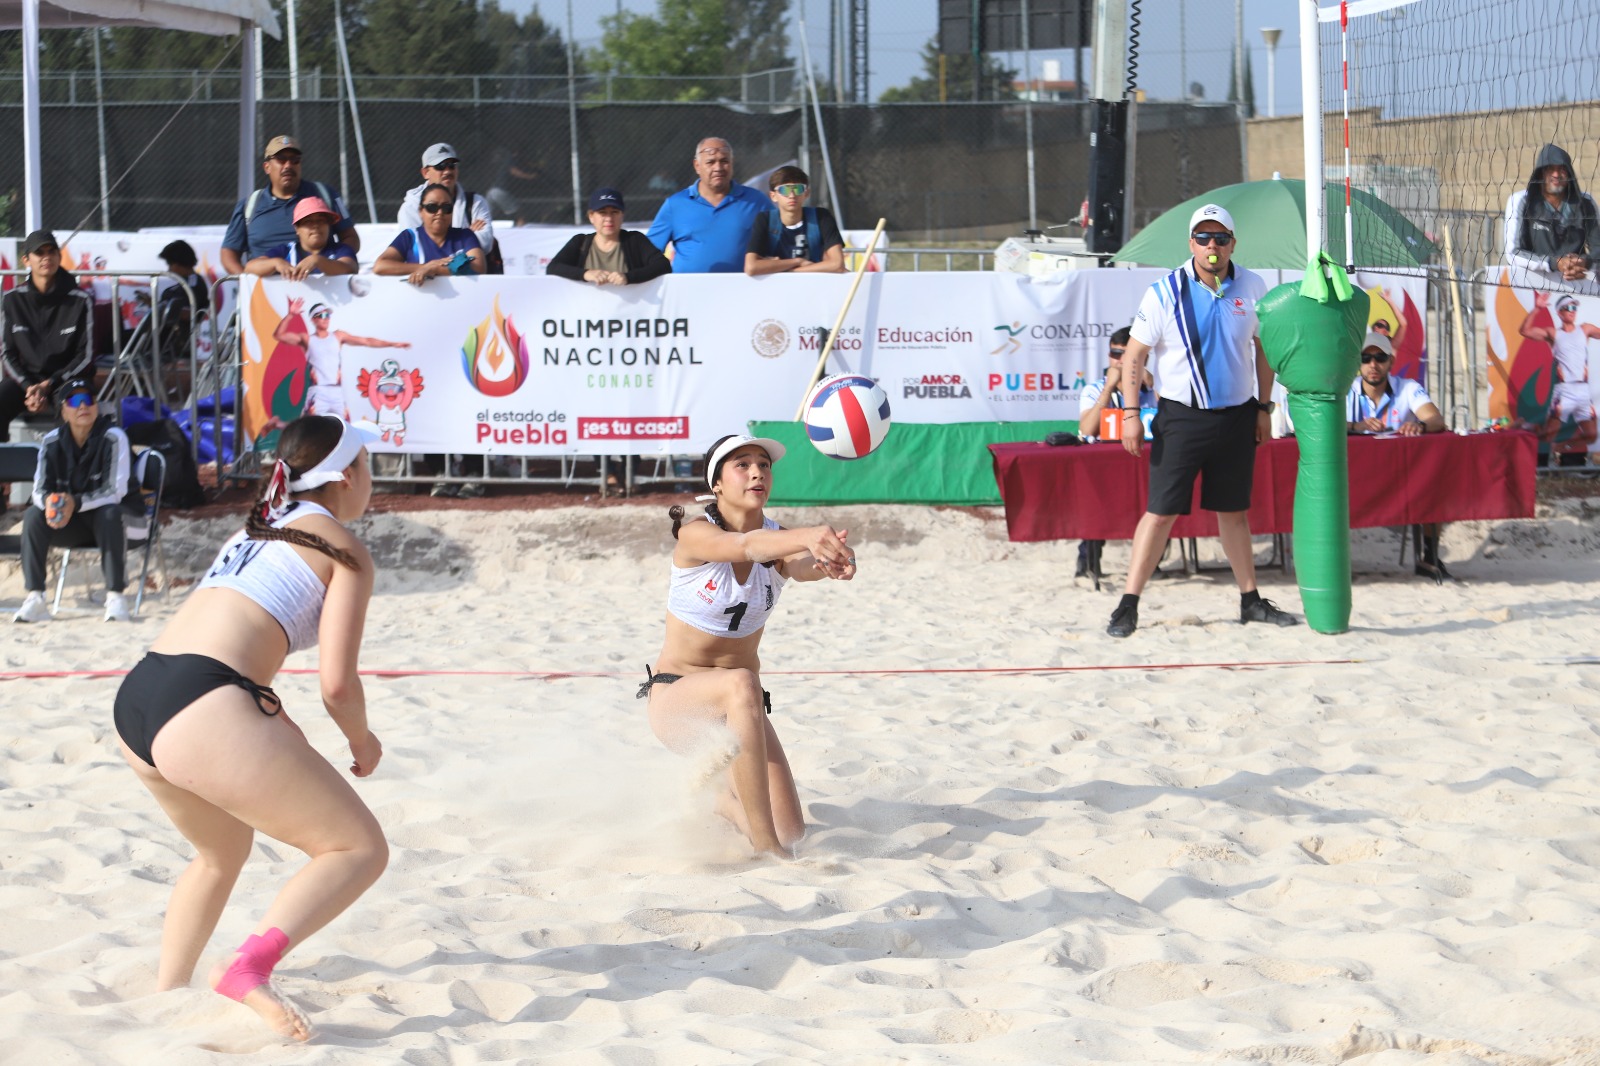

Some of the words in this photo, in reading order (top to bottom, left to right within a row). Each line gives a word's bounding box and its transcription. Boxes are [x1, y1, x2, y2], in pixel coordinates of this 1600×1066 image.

[542, 318, 689, 338] OLIMPIADA
[849, 326, 861, 335] de
[877, 327, 973, 343] Educación
[1030, 323, 1114, 340] CONADE
[798, 335, 862, 350] Mico
[543, 347, 703, 366] NACIONAL
[587, 374, 655, 388] CONADE
[920, 375, 961, 385] AMOR
[988, 372, 1088, 391] PUEBLA
[903, 385, 973, 399] PUEBLA
[476, 409, 489, 422] el
[493, 410, 544, 423] estado
[547, 410, 566, 422] de
[476, 423, 567, 445] Puebla
[612, 420, 632, 435] tu
[634, 419, 684, 435] casa!
[1105, 413, 1117, 439] 1
[723, 601, 748, 632] 1
